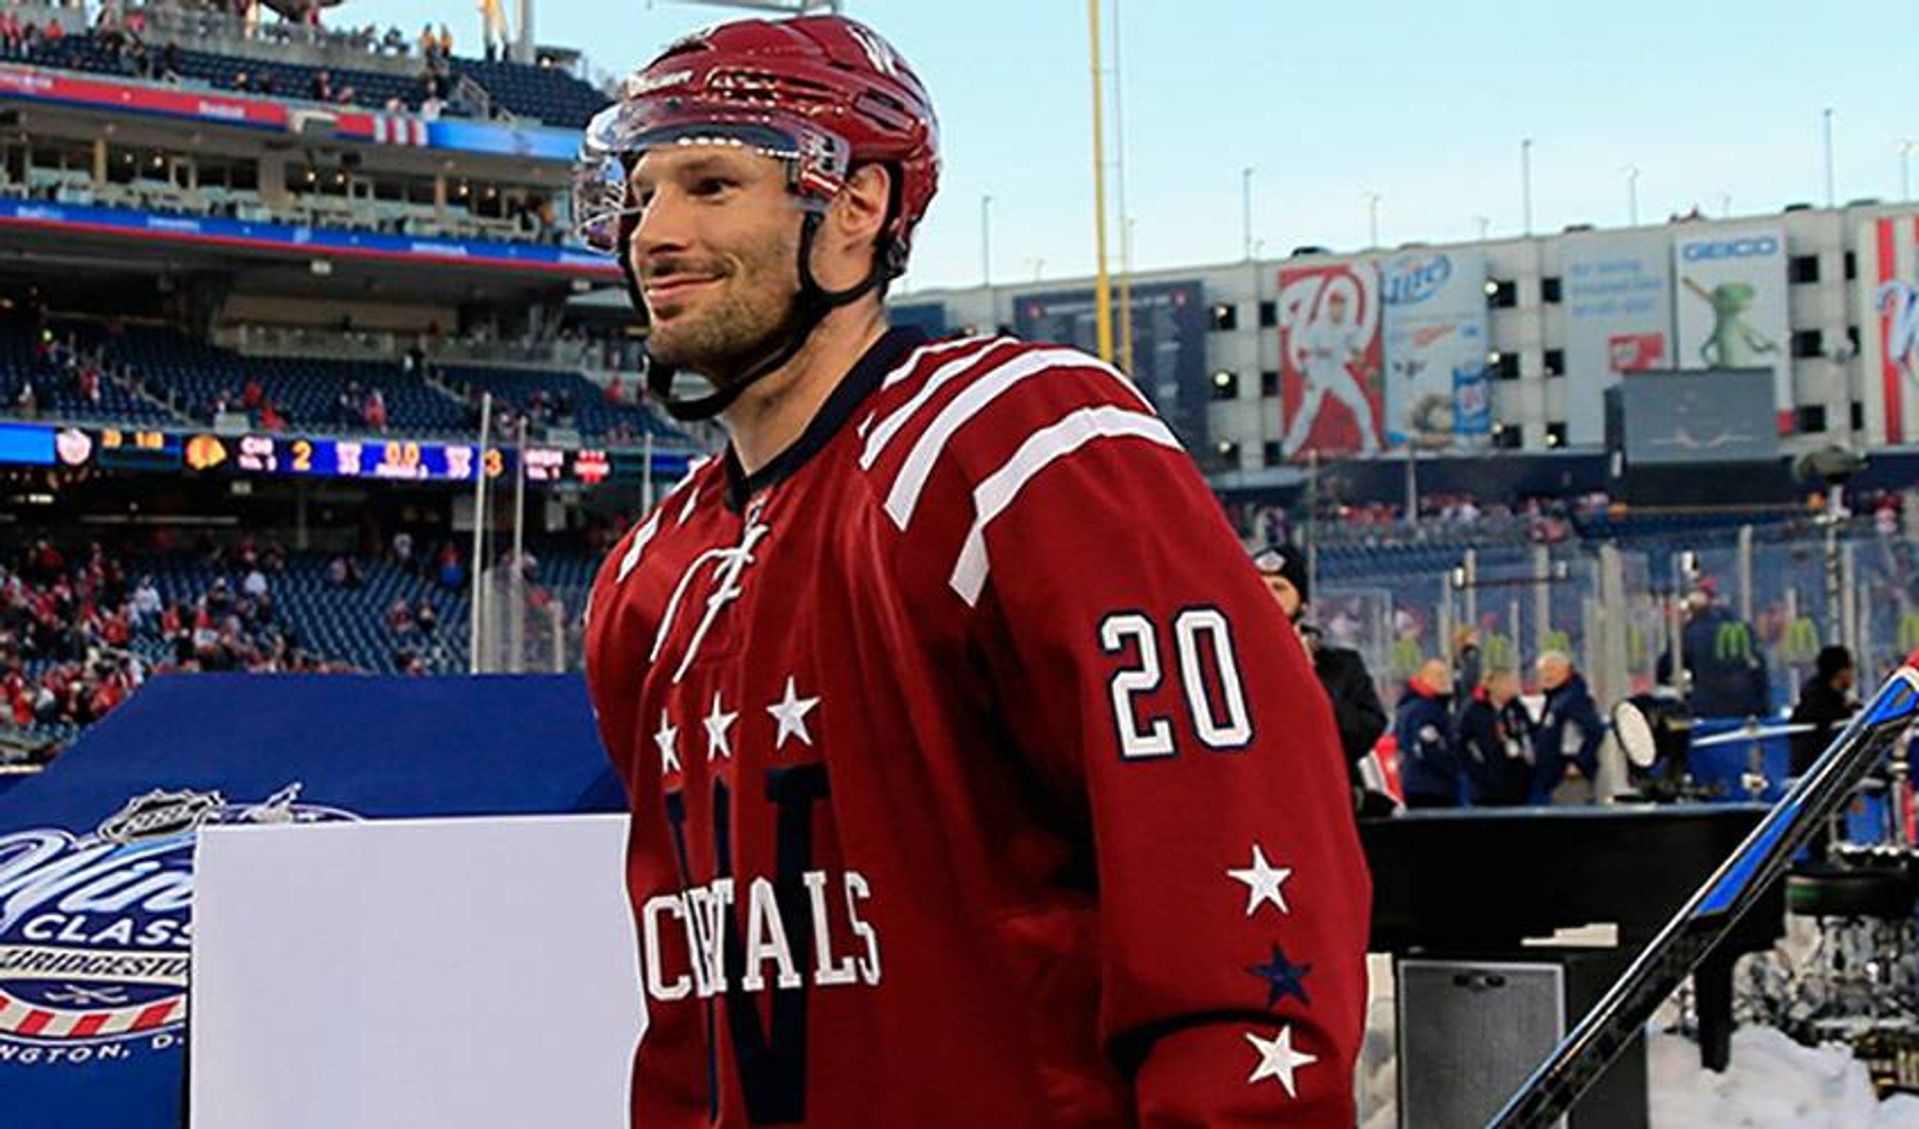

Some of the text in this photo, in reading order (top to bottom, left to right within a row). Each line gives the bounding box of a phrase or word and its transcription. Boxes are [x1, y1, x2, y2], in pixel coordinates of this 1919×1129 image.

[1684, 236, 1777, 262] GEICO
[292, 439, 312, 471] 2
[1100, 606, 1255, 761] 20
